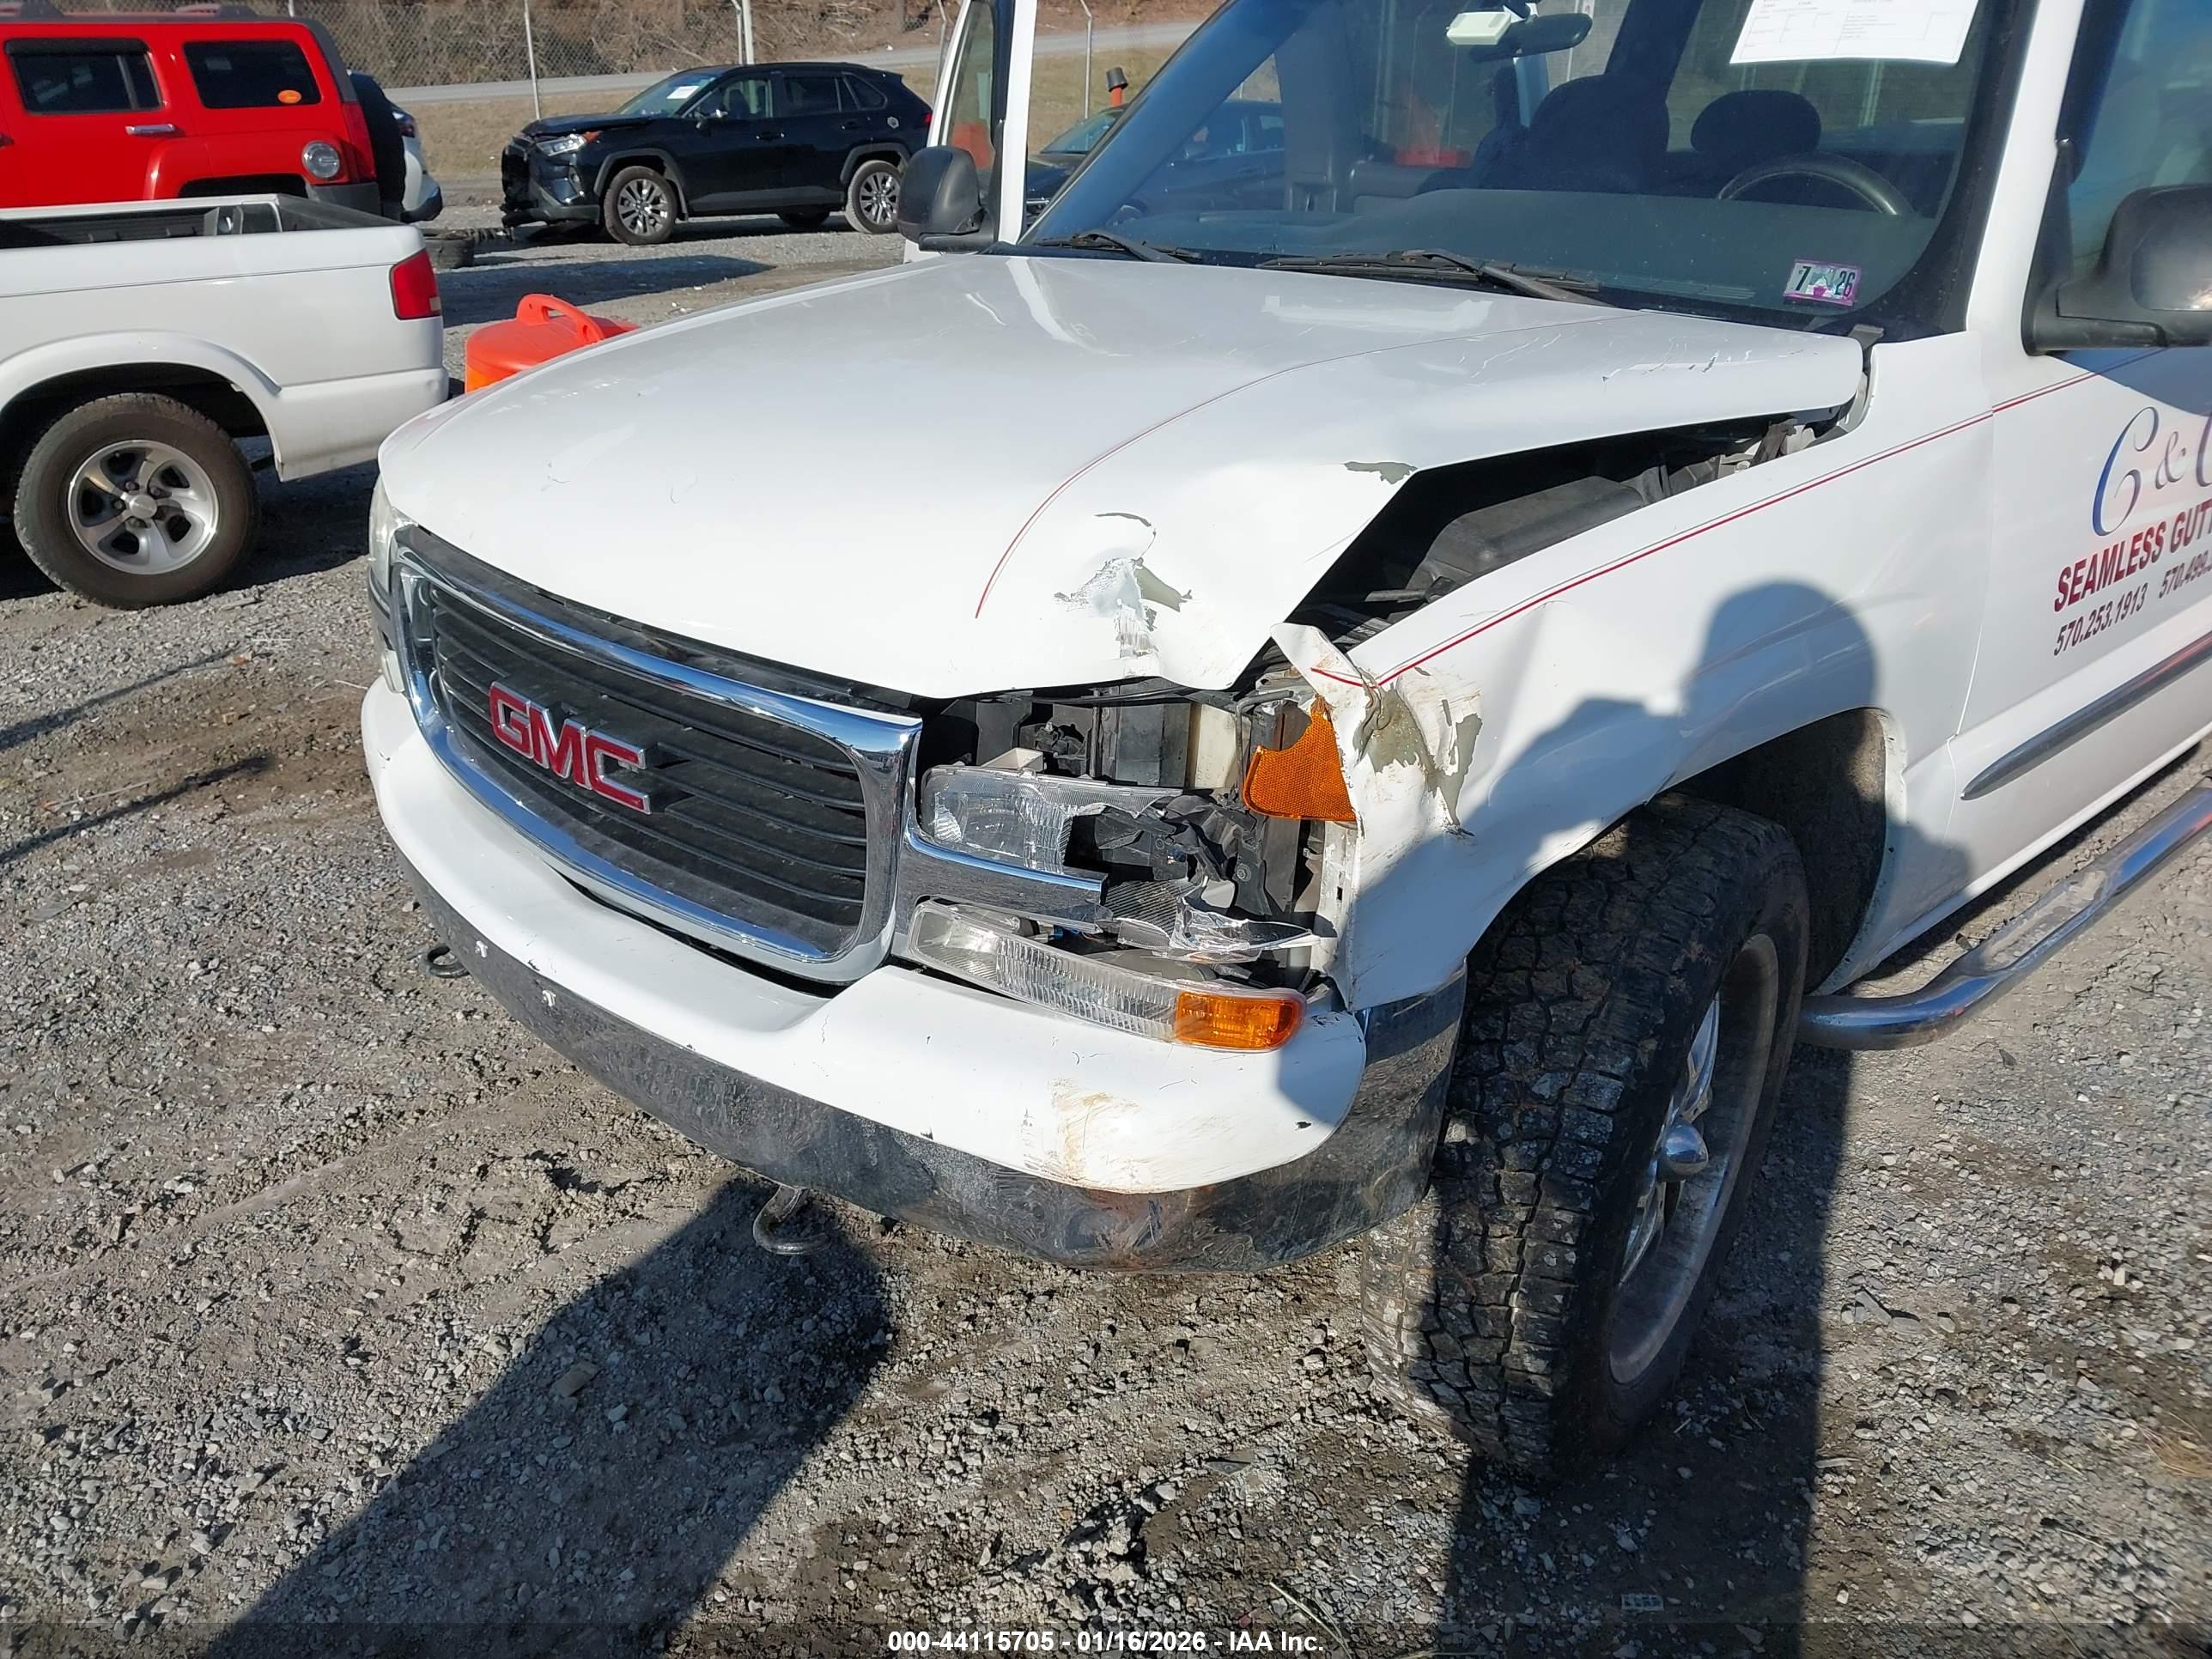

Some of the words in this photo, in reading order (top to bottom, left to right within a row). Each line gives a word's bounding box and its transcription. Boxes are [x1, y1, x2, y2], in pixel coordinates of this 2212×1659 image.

[1795, 265, 1812, 291] 7
[1834, 270, 1856, 297] 26
[2092, 406, 2159, 537] C
[2155, 431, 2186, 489] &
[2054, 520, 2166, 612] SEAMLESS
[2053, 582, 2148, 656] 570.253.1913
[489, 681, 652, 815] GMC
